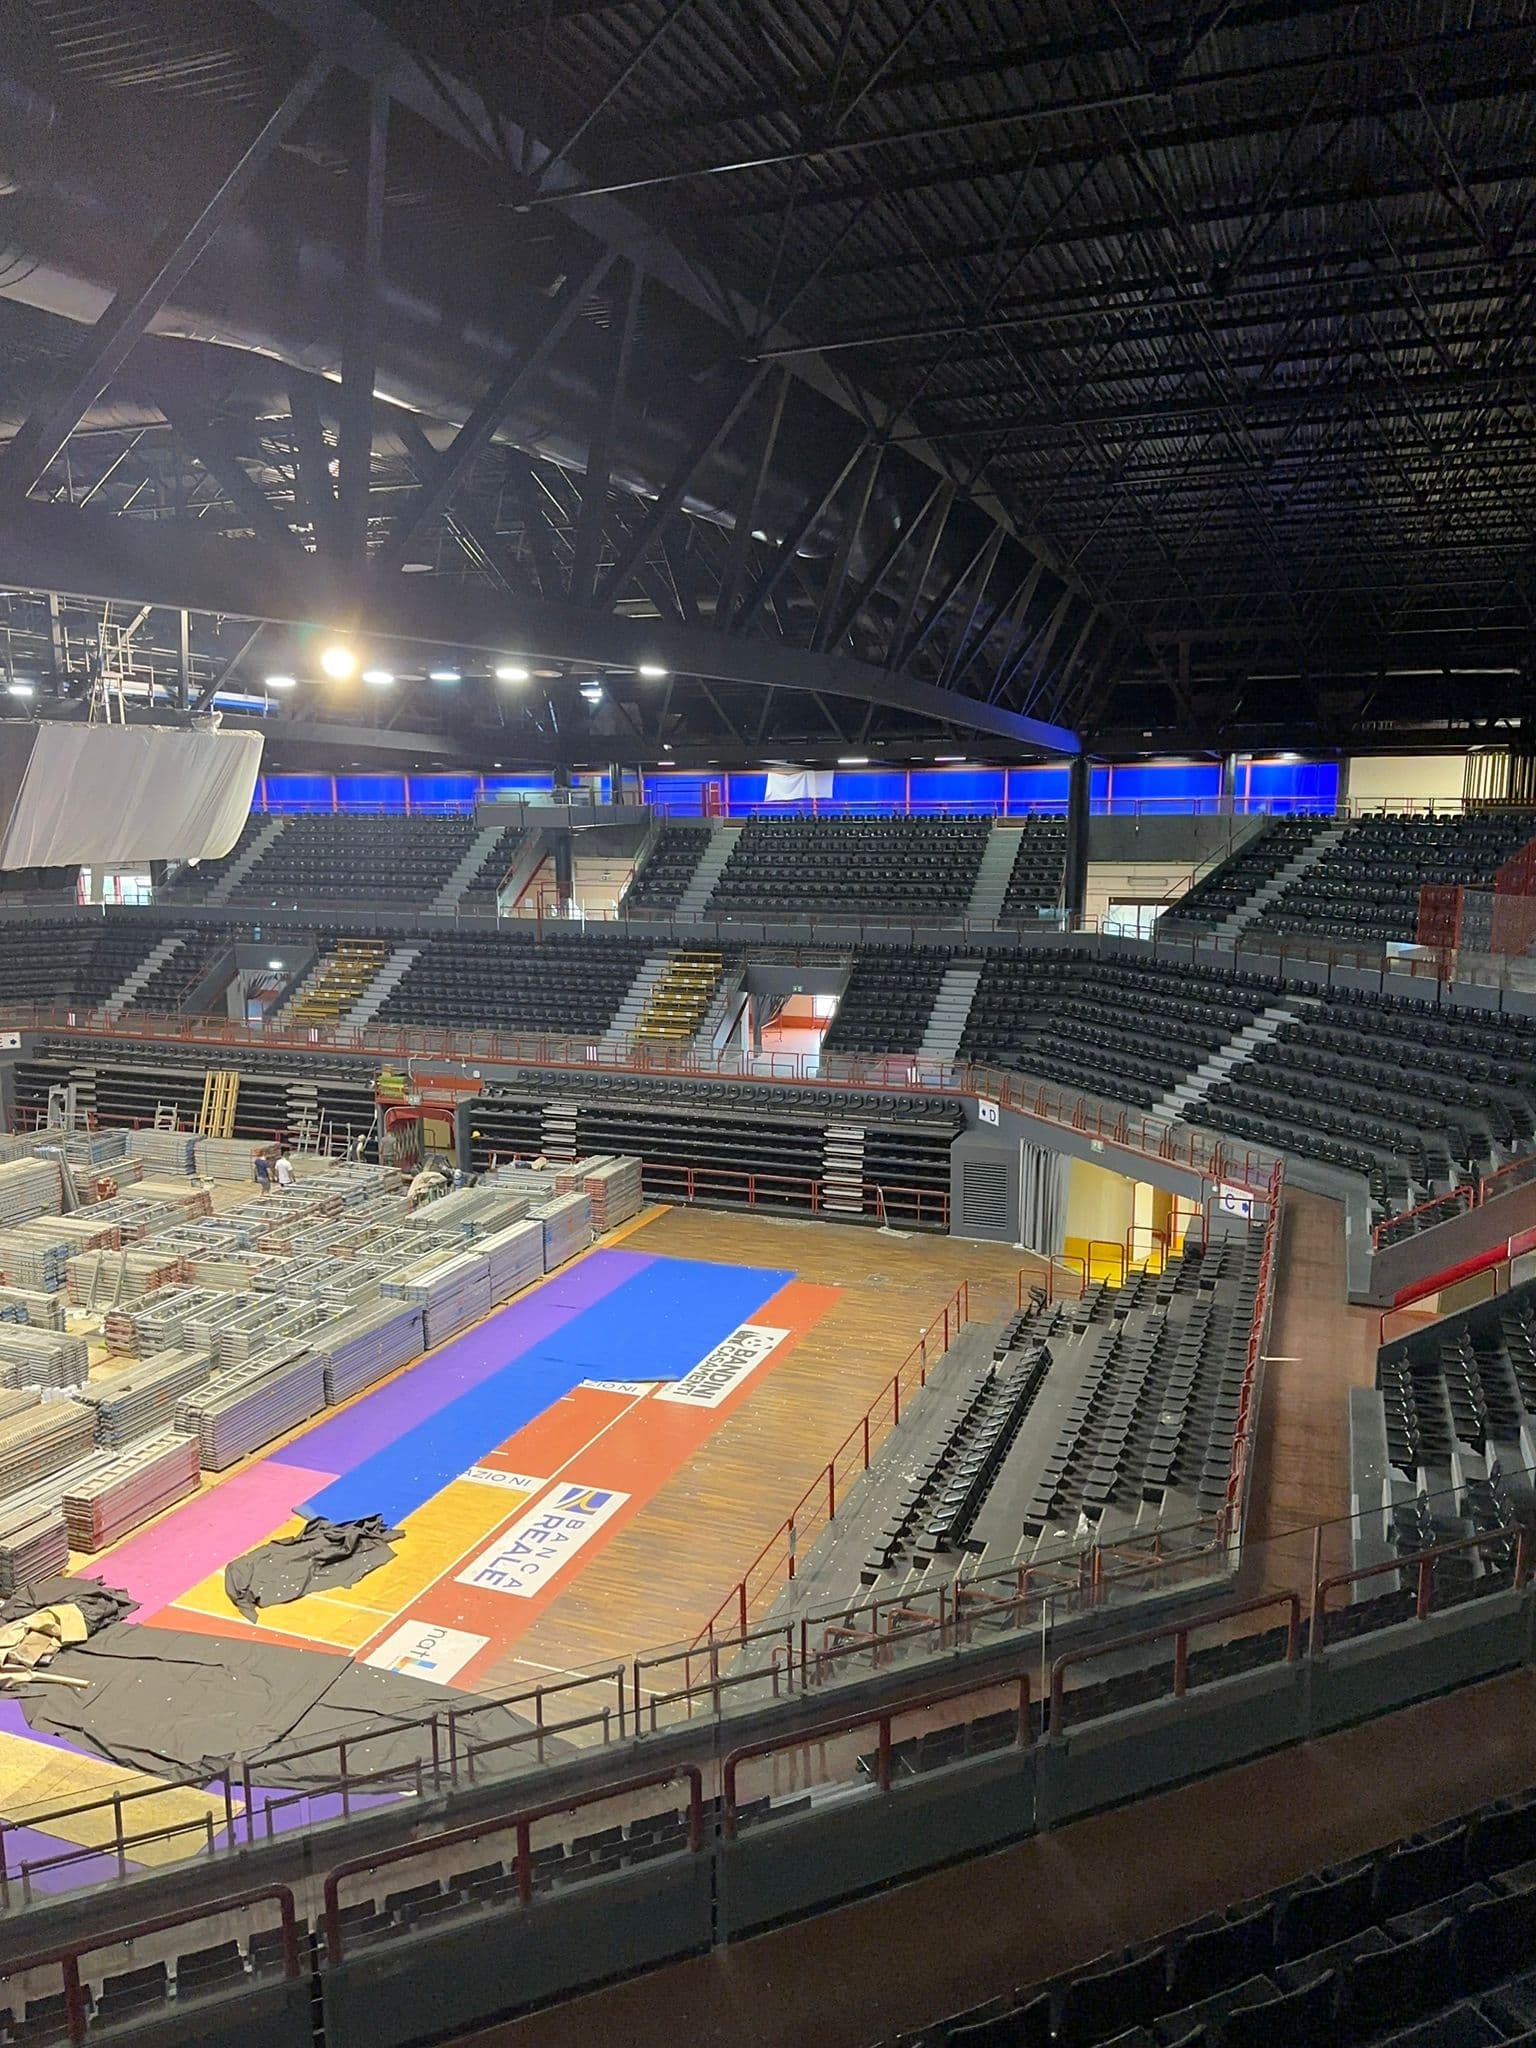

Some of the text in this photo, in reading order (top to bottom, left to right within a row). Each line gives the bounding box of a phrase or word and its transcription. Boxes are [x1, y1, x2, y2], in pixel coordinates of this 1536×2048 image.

[989, 1109, 997, 1122] D
[1225, 1193, 1236, 1210] C
[672, 1345, 736, 1396] CASAMENTI
[690, 1348, 758, 1399] BANDINI
[473, 1513, 566, 1587] REALE
[502, 1519, 586, 1589] BANCA
